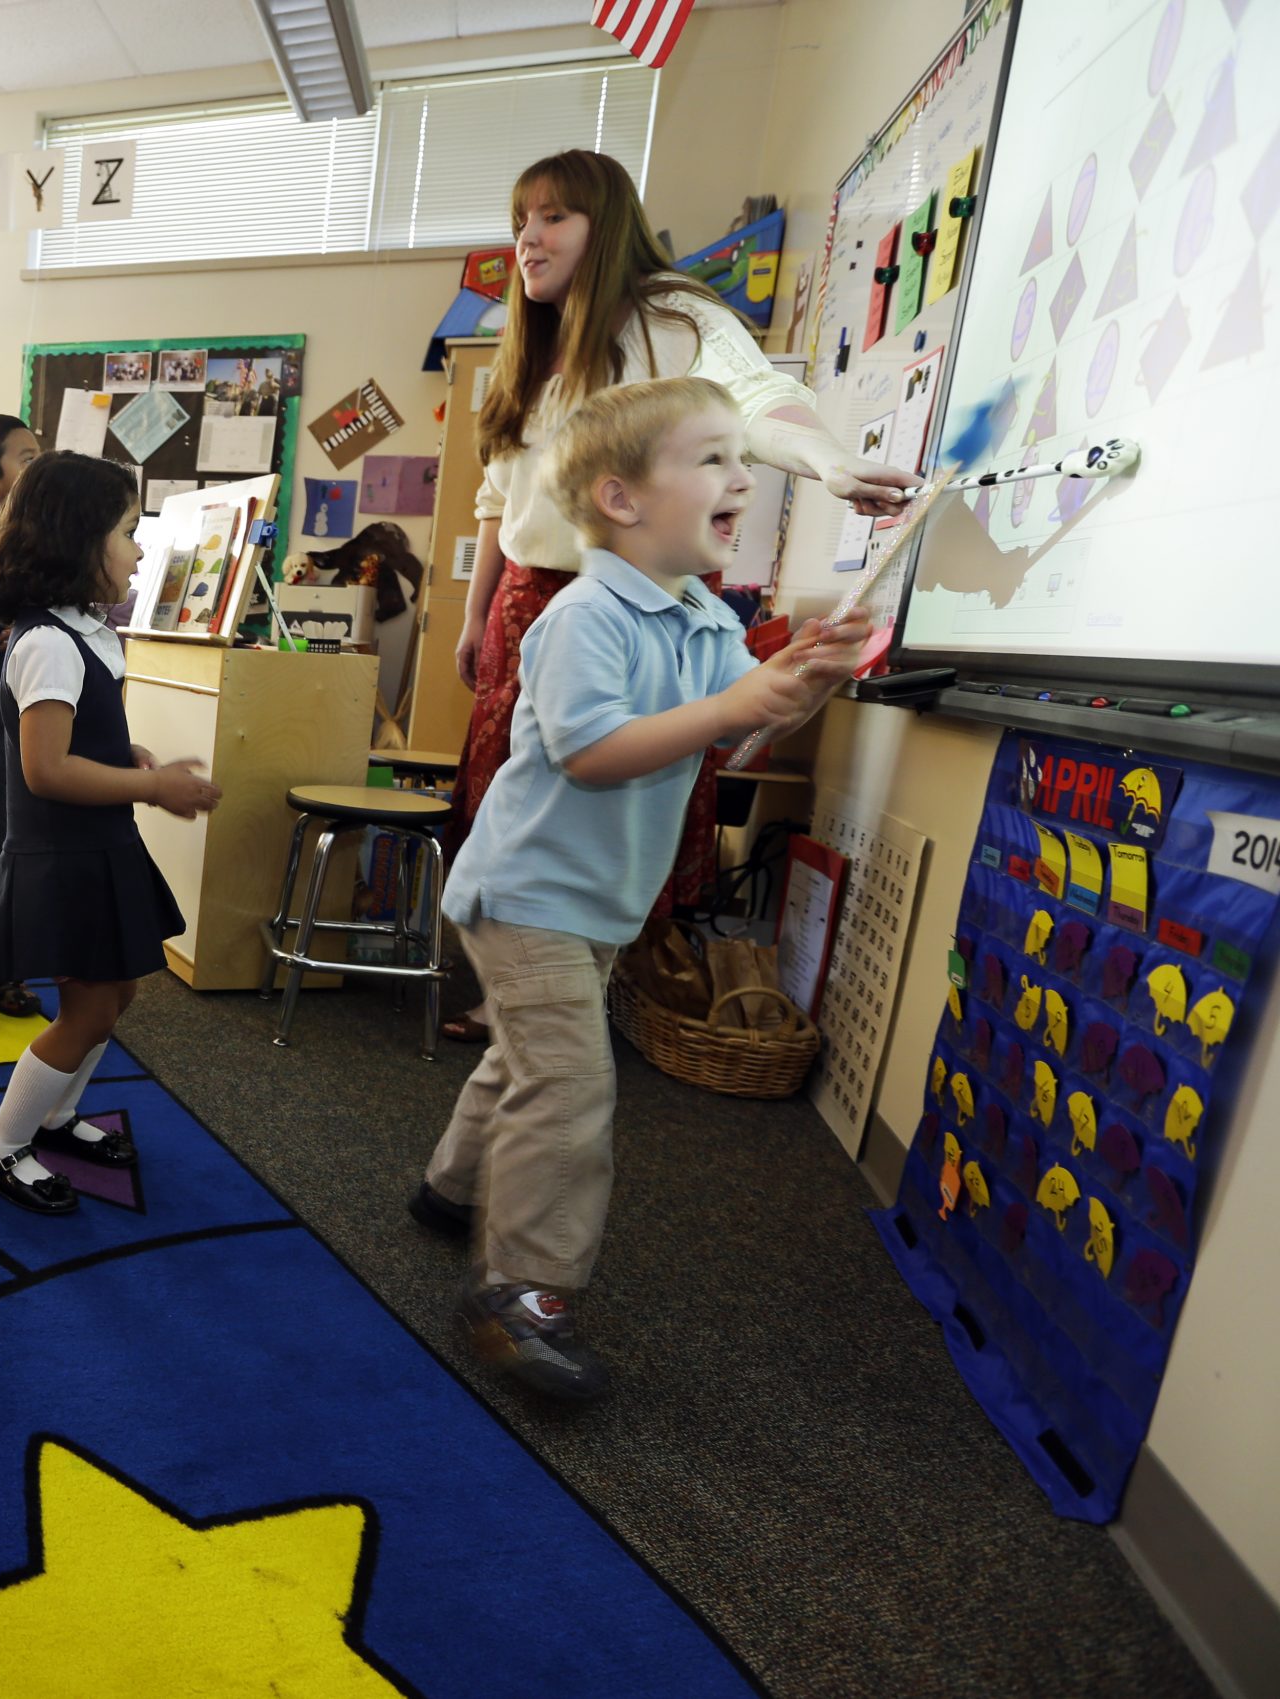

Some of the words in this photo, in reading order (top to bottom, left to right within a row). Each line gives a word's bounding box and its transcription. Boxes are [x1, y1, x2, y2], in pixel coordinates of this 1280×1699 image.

[25, 166, 56, 213] Y
[92, 158, 124, 206] Z
[1033, 754, 1115, 830] APRIL
[830, 818, 835, 831] 2
[840, 823, 845, 836] 3
[860, 833, 865, 847] 5
[879, 843, 884, 857] 7
[1071, 834, 1091, 856] Today
[1052, 1012, 1062, 1028] 9
[1163, 980, 1174, 1003] 4
[1205, 1005, 1221, 1029] 5
[1050, 1177, 1065, 1200] 24
[1095, 1222, 1108, 1254] 25
